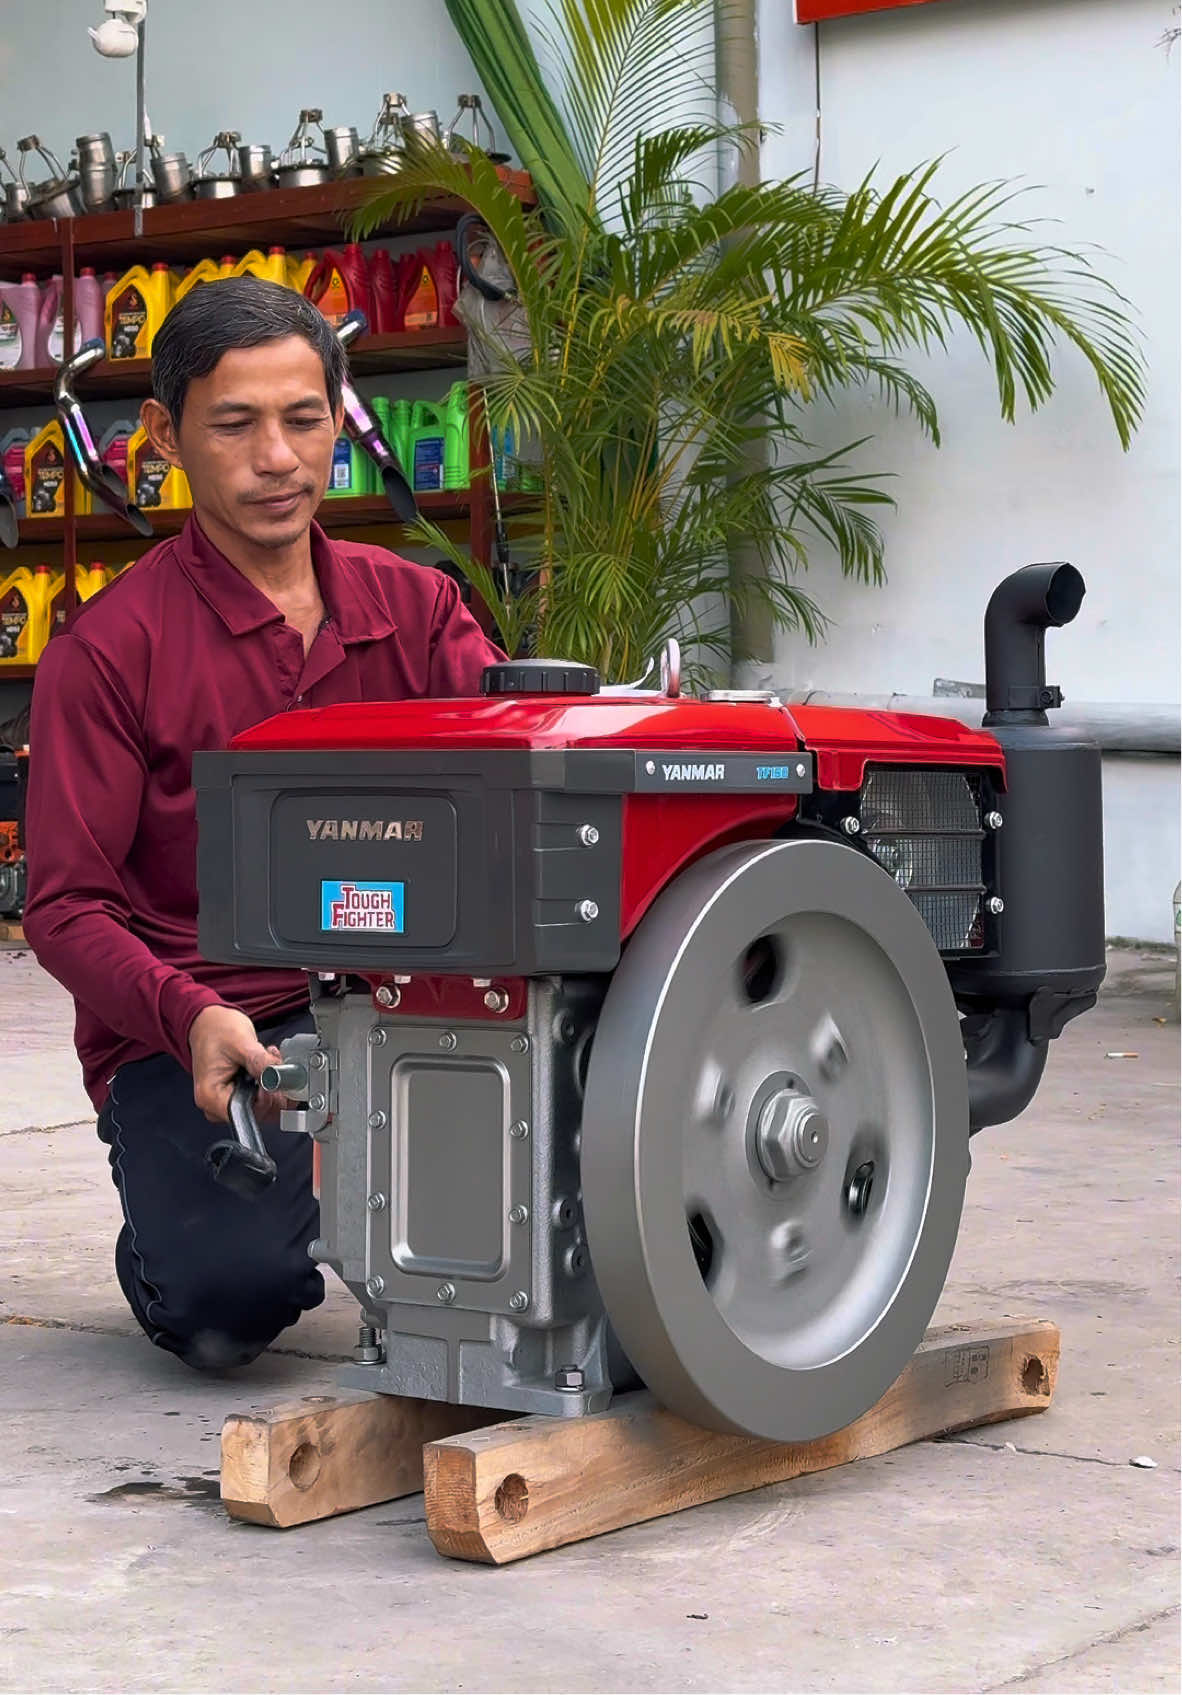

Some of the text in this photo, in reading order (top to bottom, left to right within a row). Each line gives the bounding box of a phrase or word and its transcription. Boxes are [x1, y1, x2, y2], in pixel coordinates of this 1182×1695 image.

[662, 764, 725, 781] YANMAR
[306, 819, 424, 841] YANMAR
[342, 886, 391, 909] TOUGH
[332, 903, 394, 928] FIGHTER
